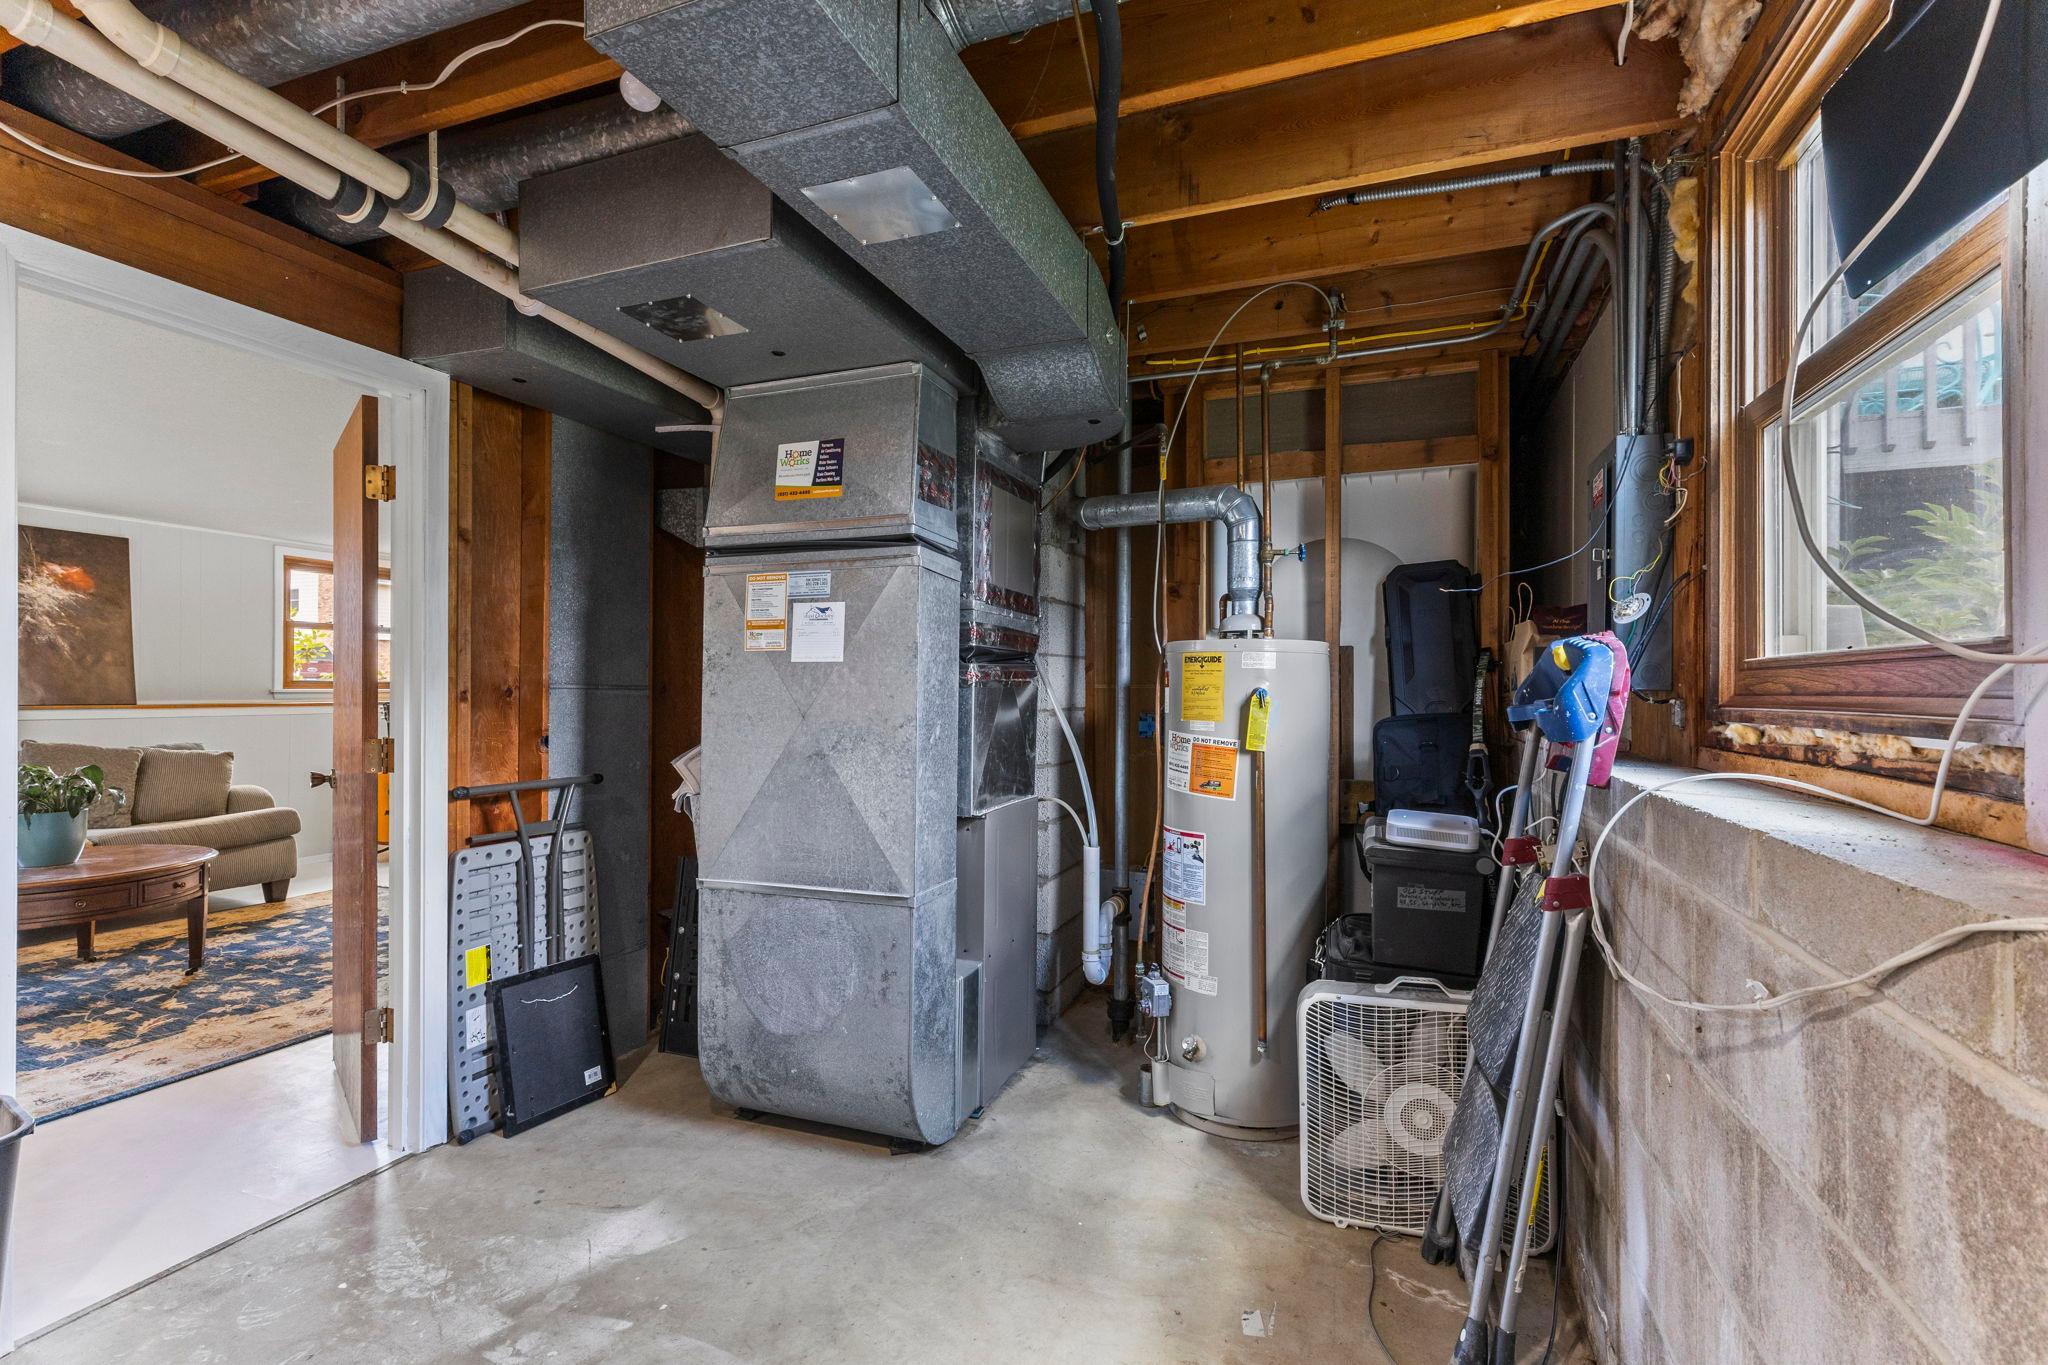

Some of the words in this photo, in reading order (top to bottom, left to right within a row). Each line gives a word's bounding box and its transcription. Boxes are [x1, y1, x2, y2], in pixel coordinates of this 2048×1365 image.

[785, 449, 812, 459] Home
[780, 457, 810, 467] Works
[1171, 732, 1191, 745] Home
[1212, 739, 1238, 747] REMOVE
